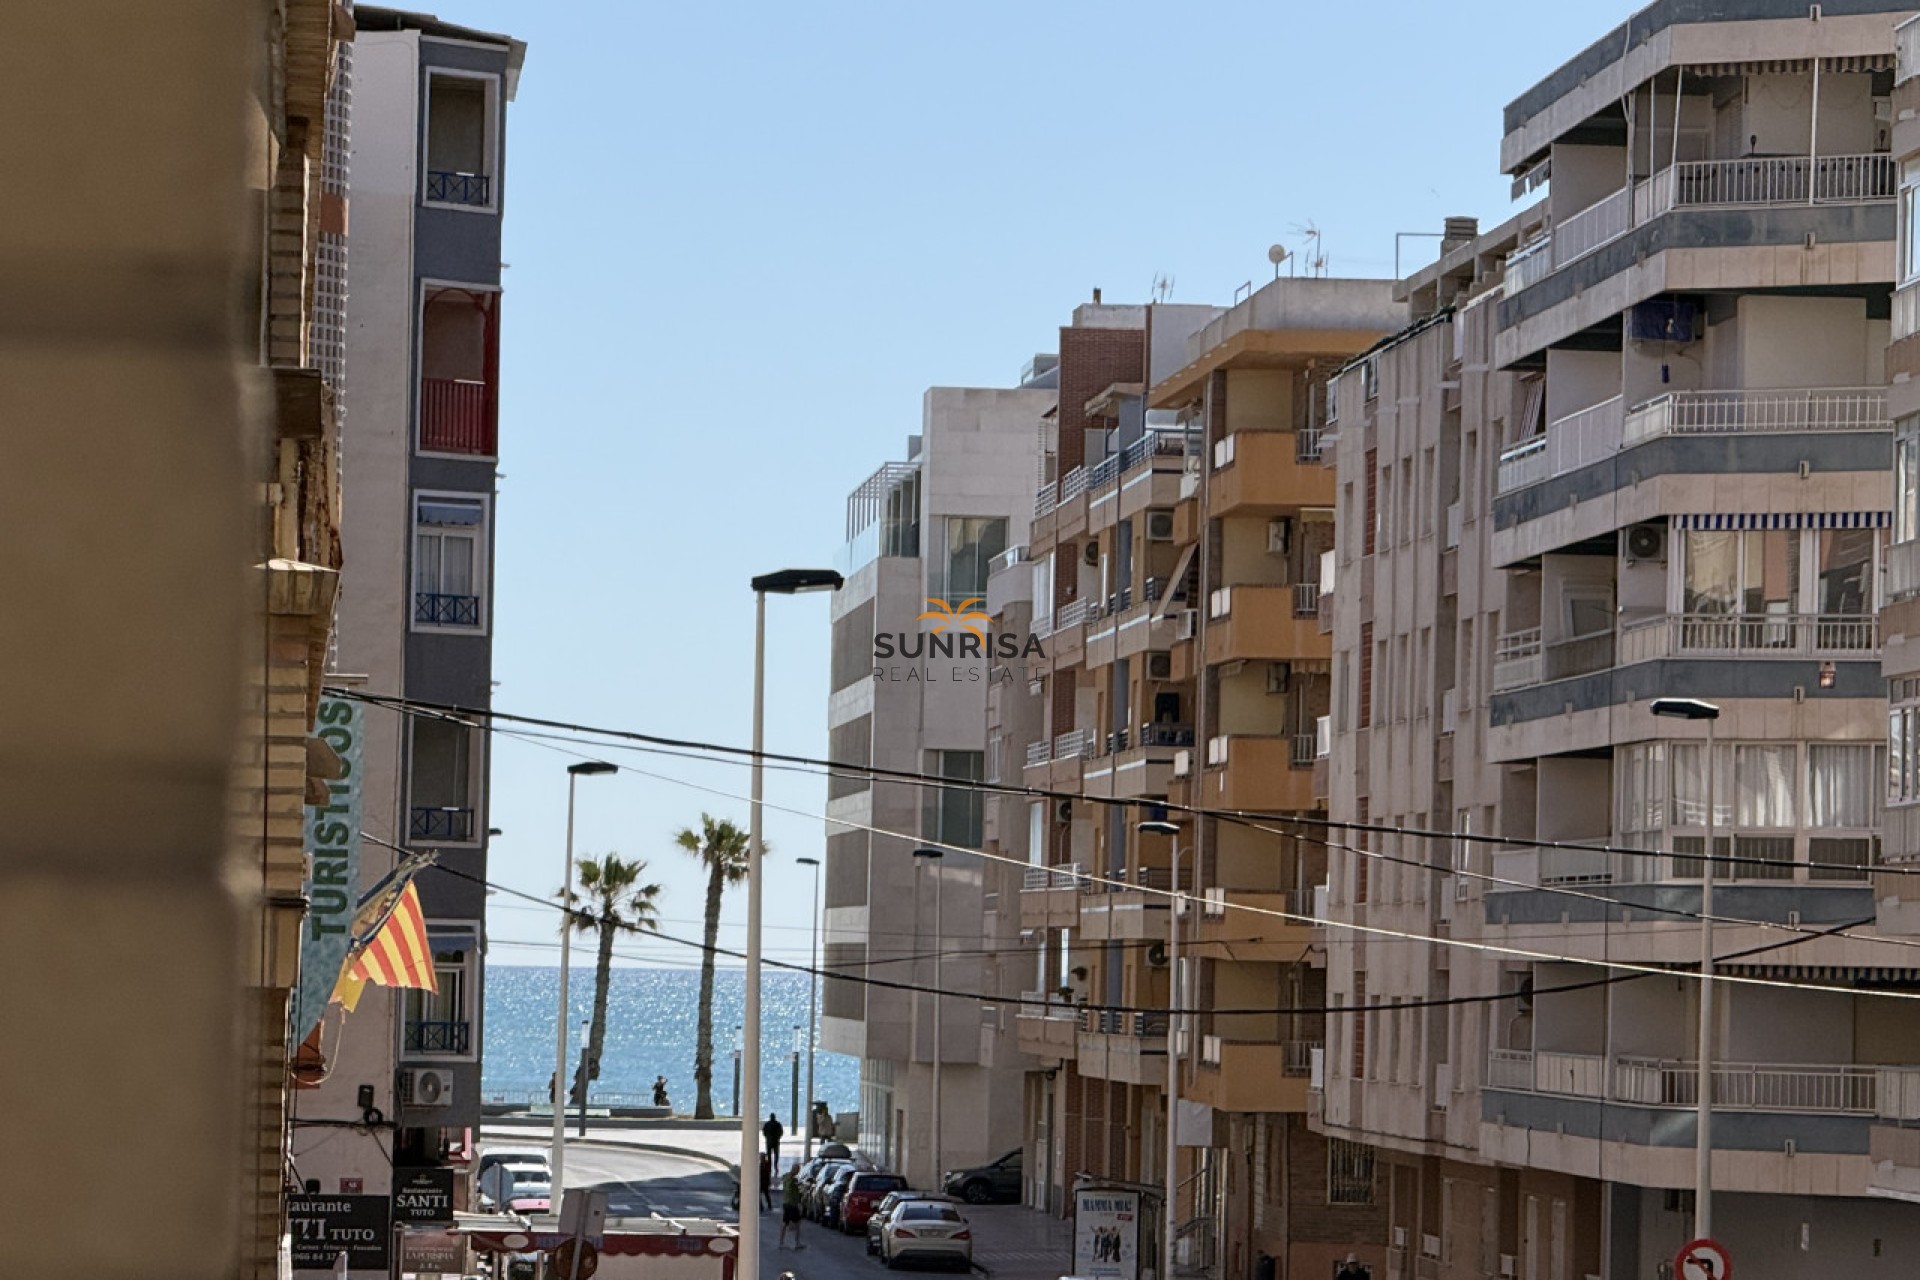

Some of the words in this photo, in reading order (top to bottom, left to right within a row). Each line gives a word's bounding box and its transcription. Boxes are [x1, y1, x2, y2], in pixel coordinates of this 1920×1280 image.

[311, 701, 353, 942] TURISTIOS
[396, 1194, 448, 1208] SANTI
[410, 1209, 436, 1217] TUTO
[330, 1228, 375, 1241] TUTO
